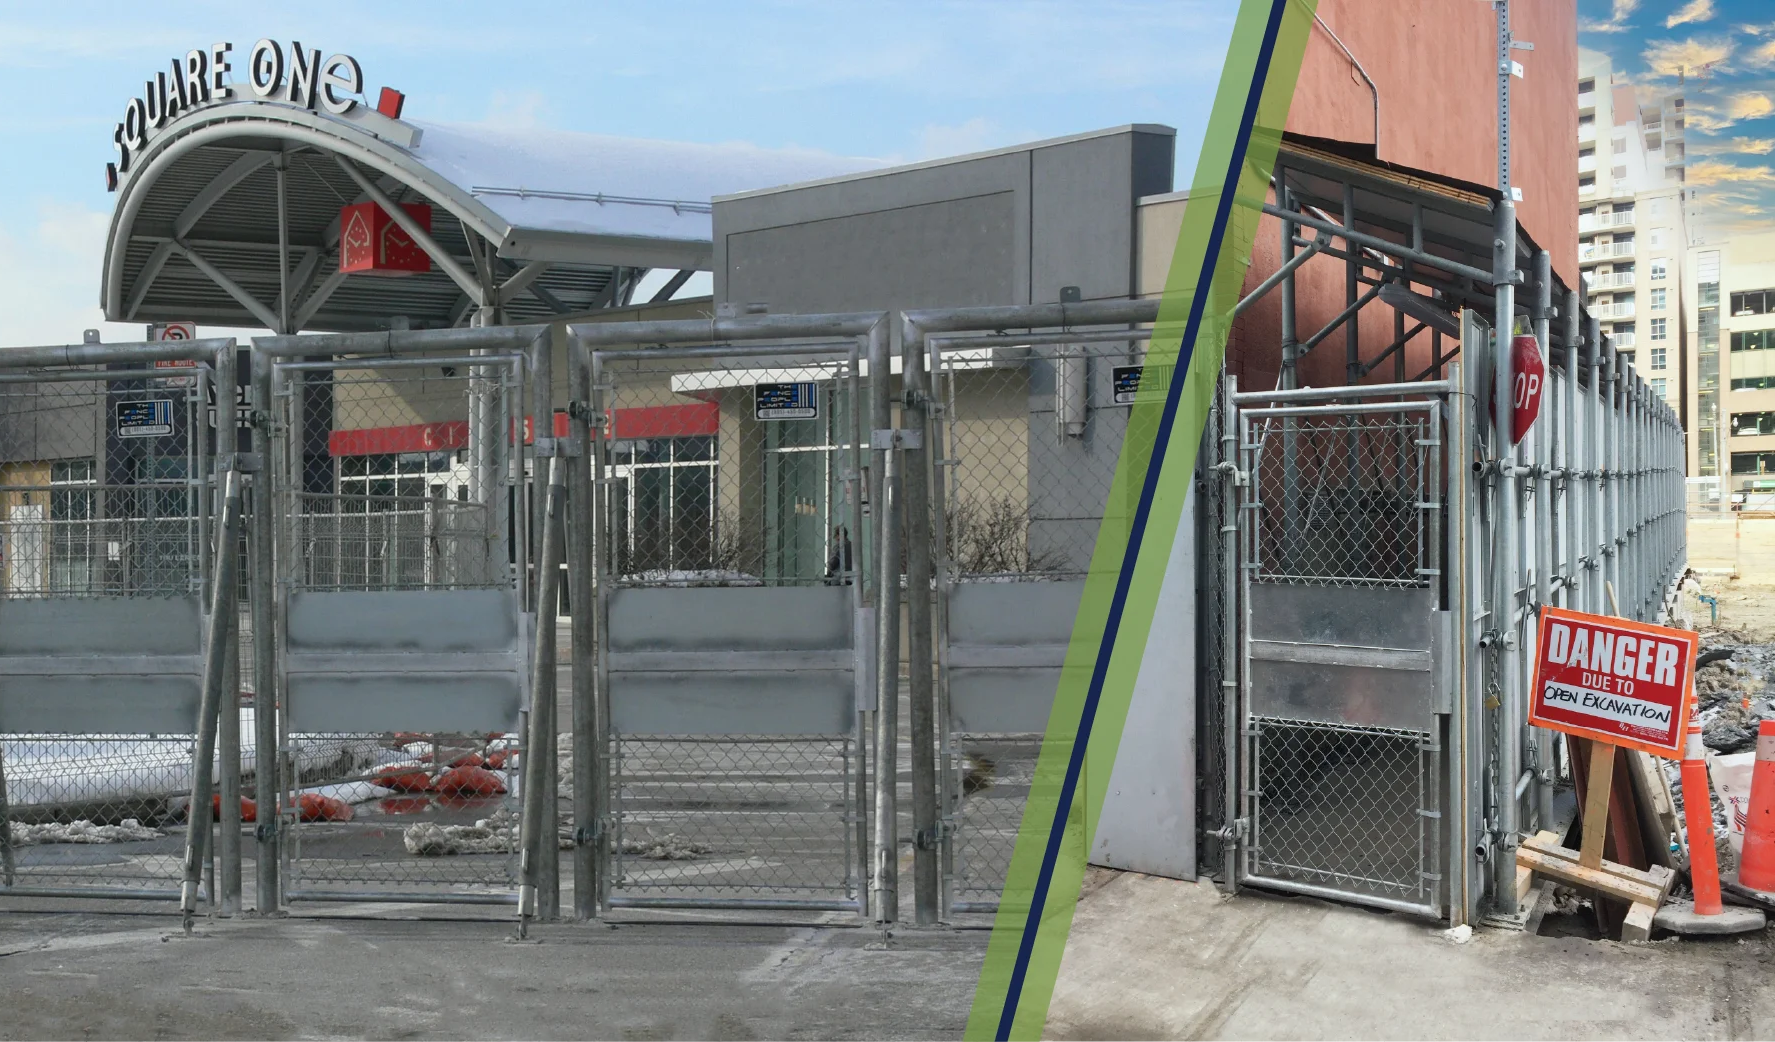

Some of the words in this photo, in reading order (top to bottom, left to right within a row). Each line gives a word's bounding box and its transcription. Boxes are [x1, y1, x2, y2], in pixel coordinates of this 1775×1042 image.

[113, 42, 232, 174] SQUARE
[1547, 622, 1679, 687] DANGER
[1543, 685, 1579, 704] OPEN
[1582, 692, 1671, 724] EXCAVATION
[1581, 671, 1611, 692] DUE
[1615, 677, 1635, 696] TO
